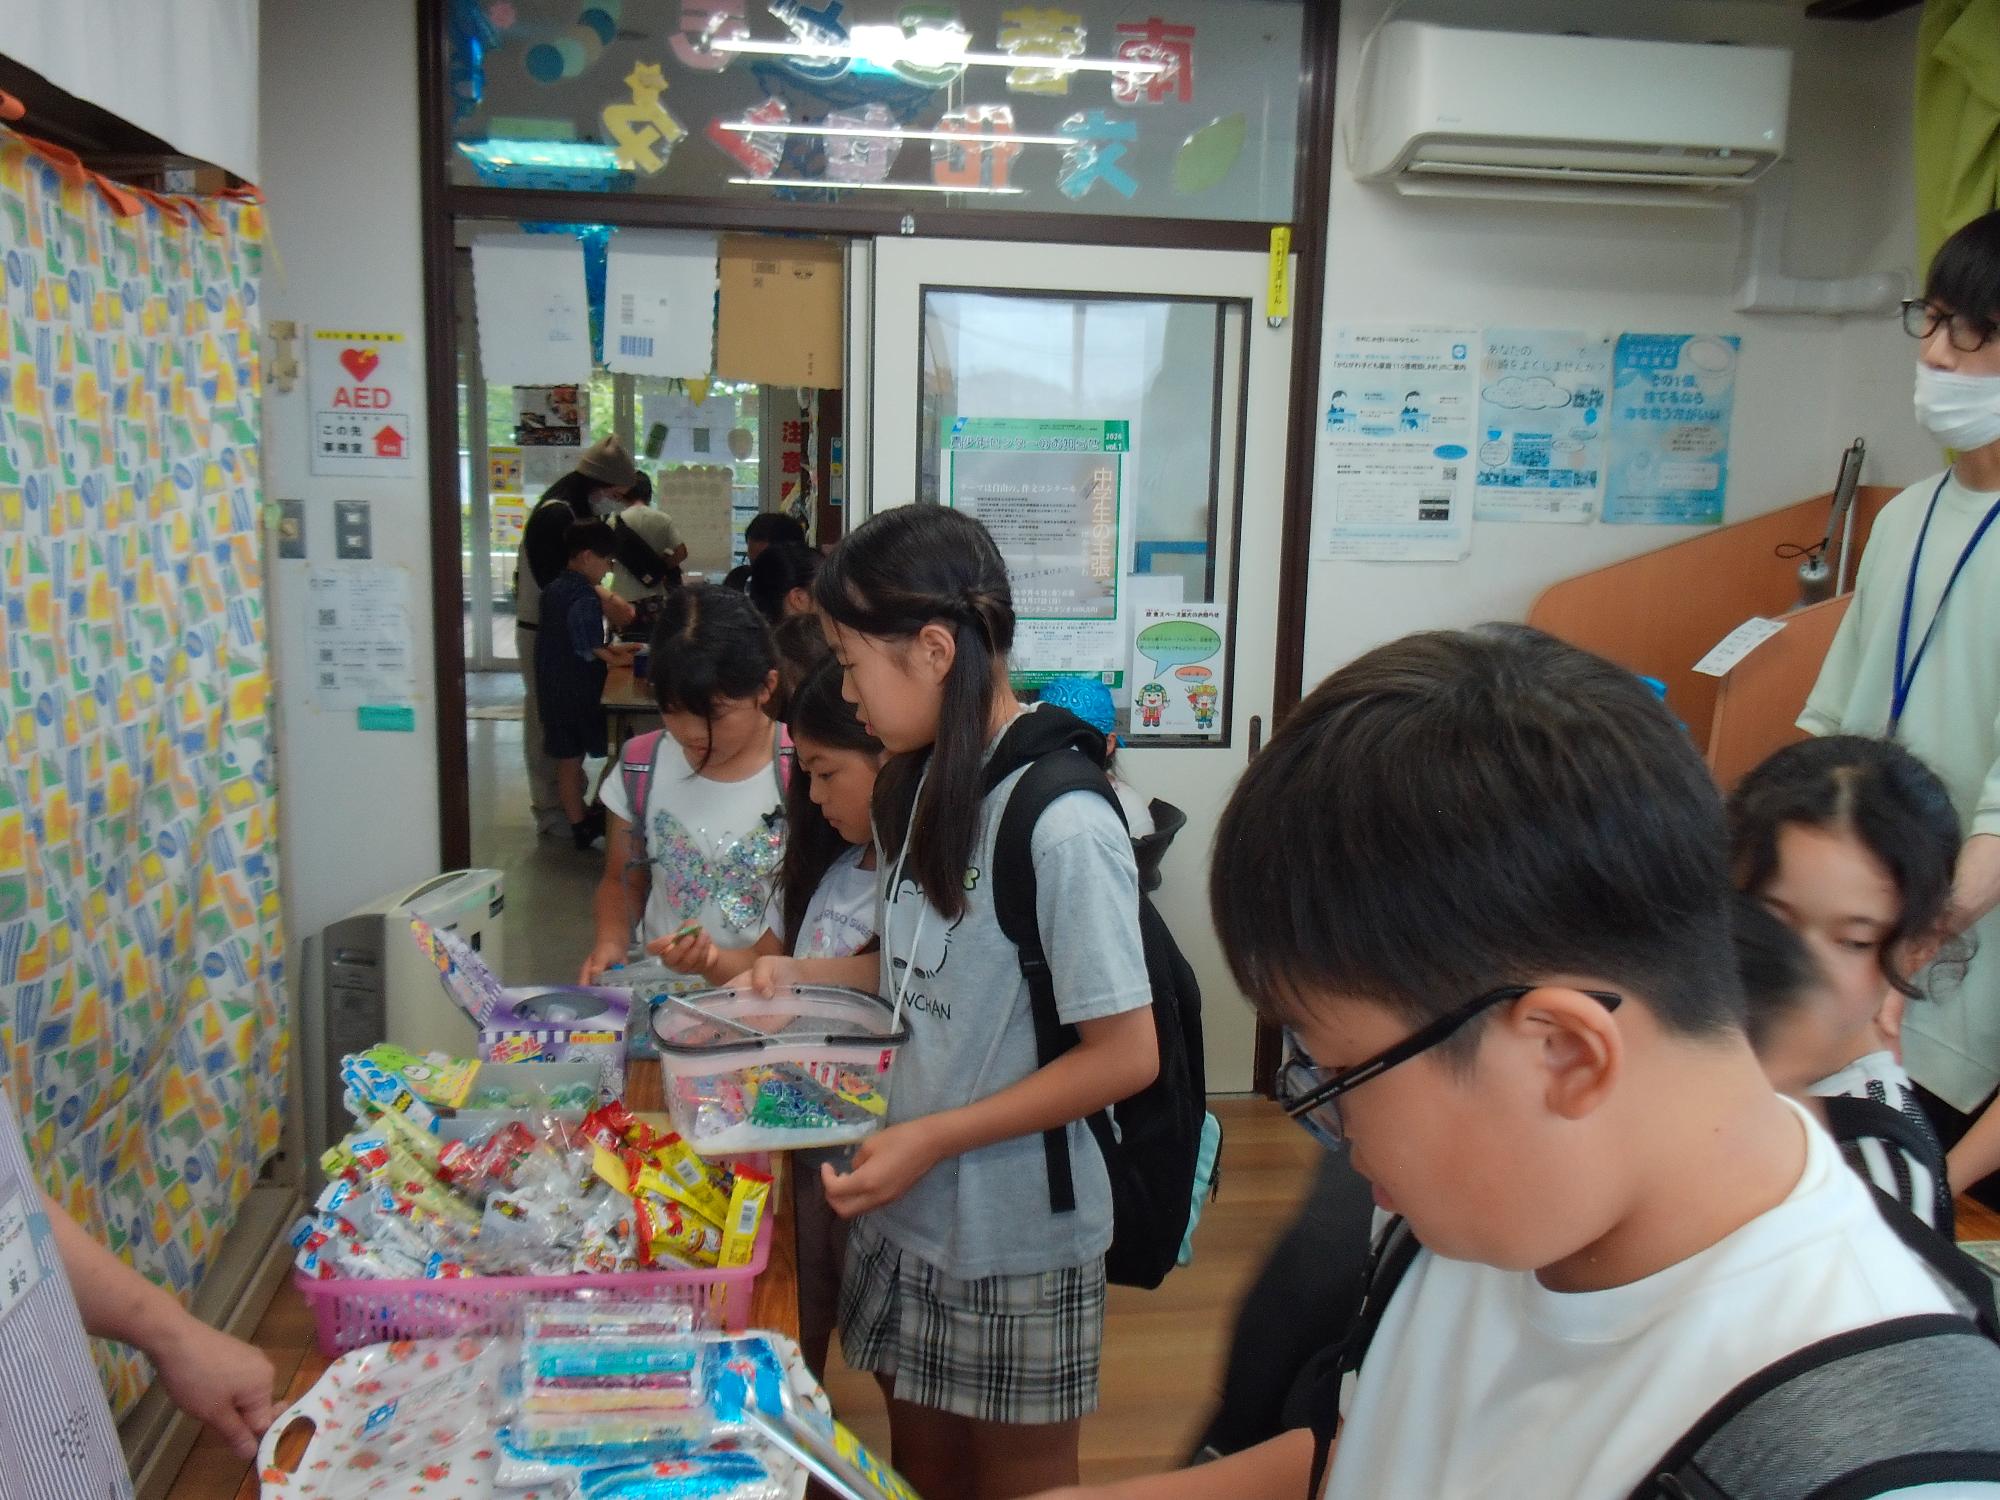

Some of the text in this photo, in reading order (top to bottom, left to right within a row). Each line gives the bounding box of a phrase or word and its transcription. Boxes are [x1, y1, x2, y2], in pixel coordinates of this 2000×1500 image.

[331, 386, 393, 409] AED
[323, 425, 362, 437] この先
[1091, 467, 1113, 577] 中学生の主張
